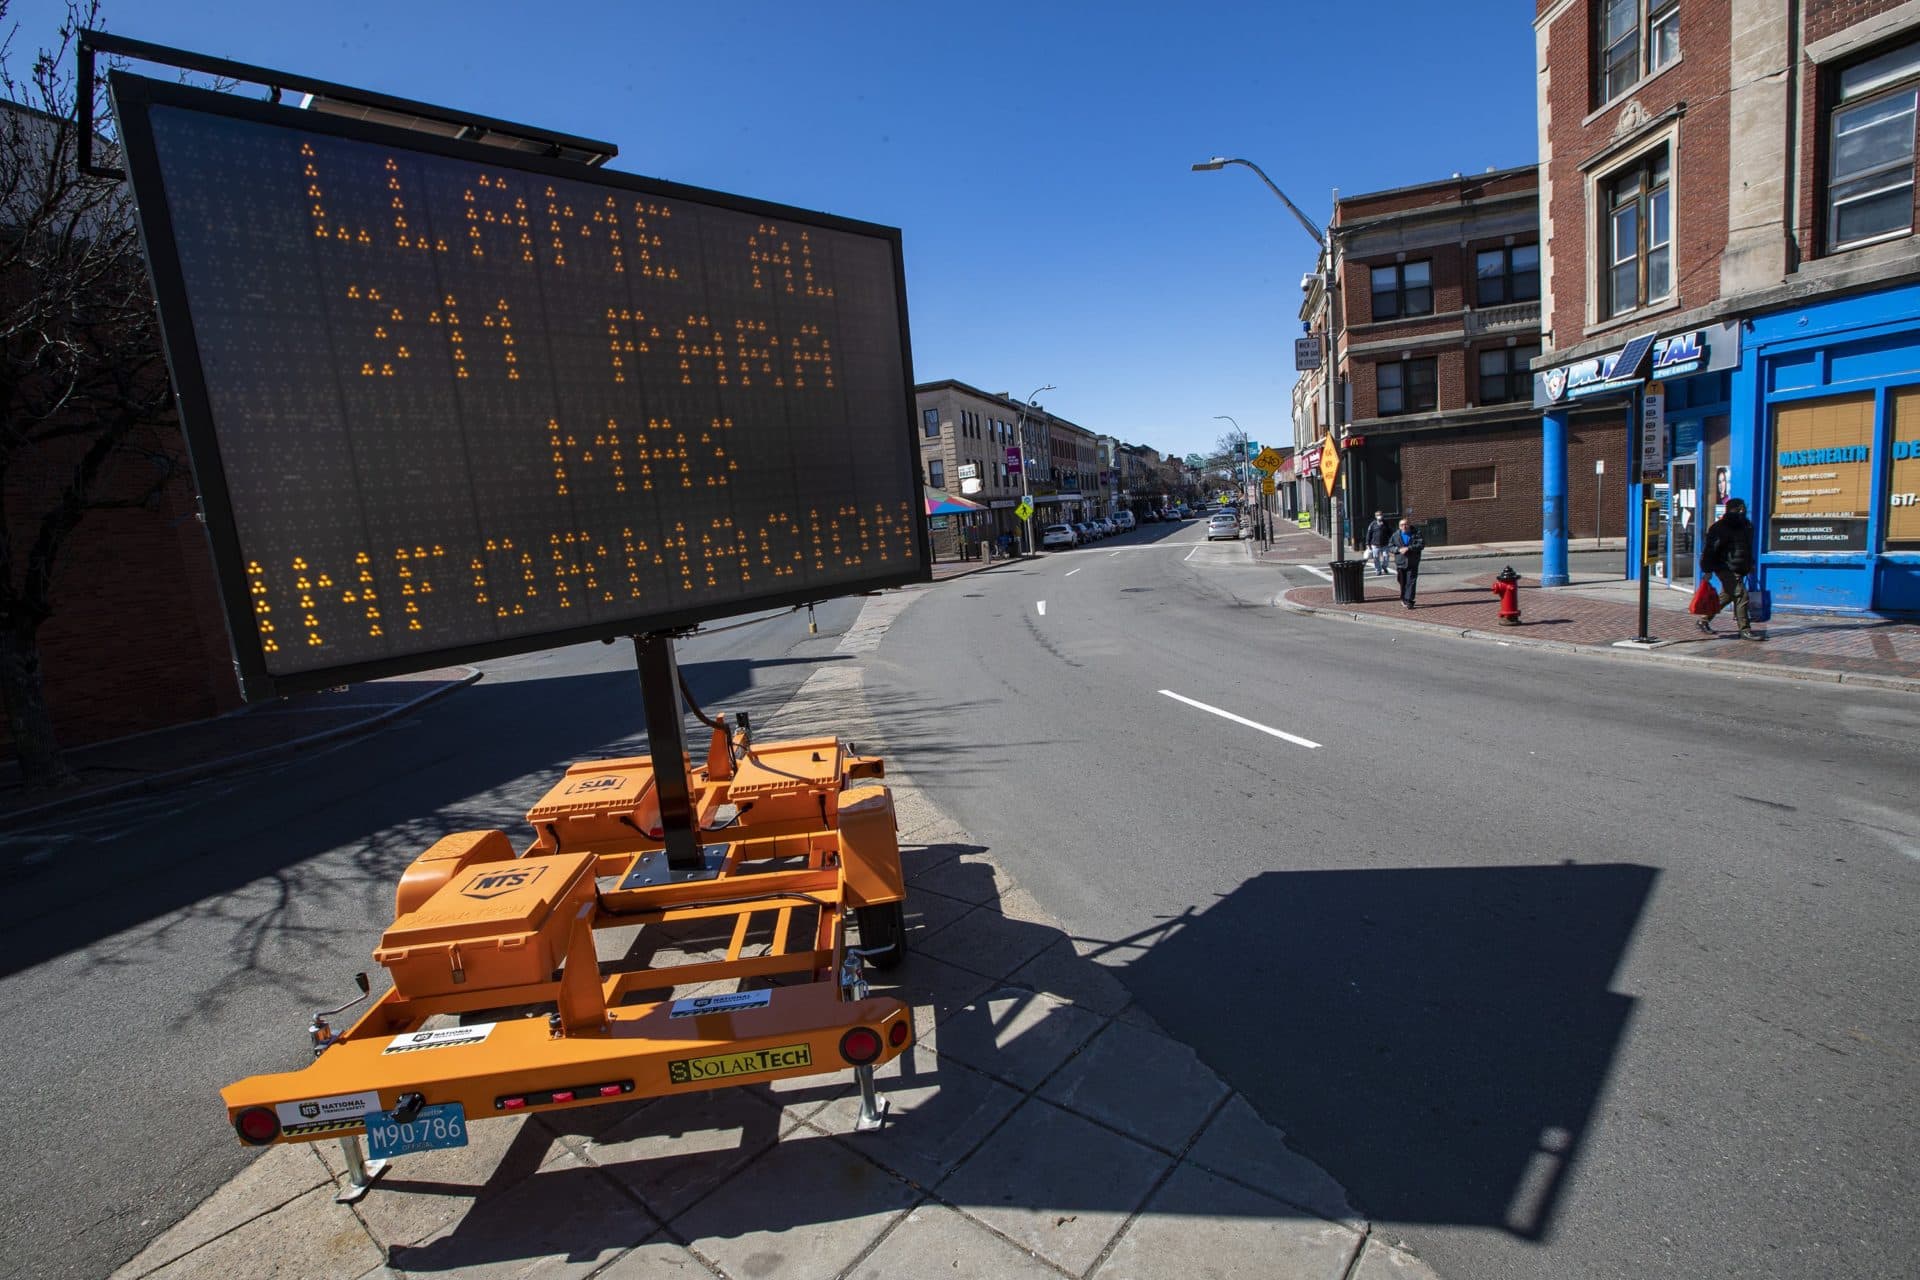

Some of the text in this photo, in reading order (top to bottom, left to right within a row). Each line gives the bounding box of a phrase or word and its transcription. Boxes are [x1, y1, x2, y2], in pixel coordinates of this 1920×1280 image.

[303, 144, 832, 295] LLAME AL
[348, 287, 832, 386] 311 PARA
[1567, 358, 1602, 388] DR.
[549, 419, 736, 494] MAS
[1779, 444, 1868, 467] MASSHEALTH
[248, 502, 911, 651] INFORMACION
[473, 873, 529, 890] NTS
[321, 1099, 366, 1110] NATIONAL
